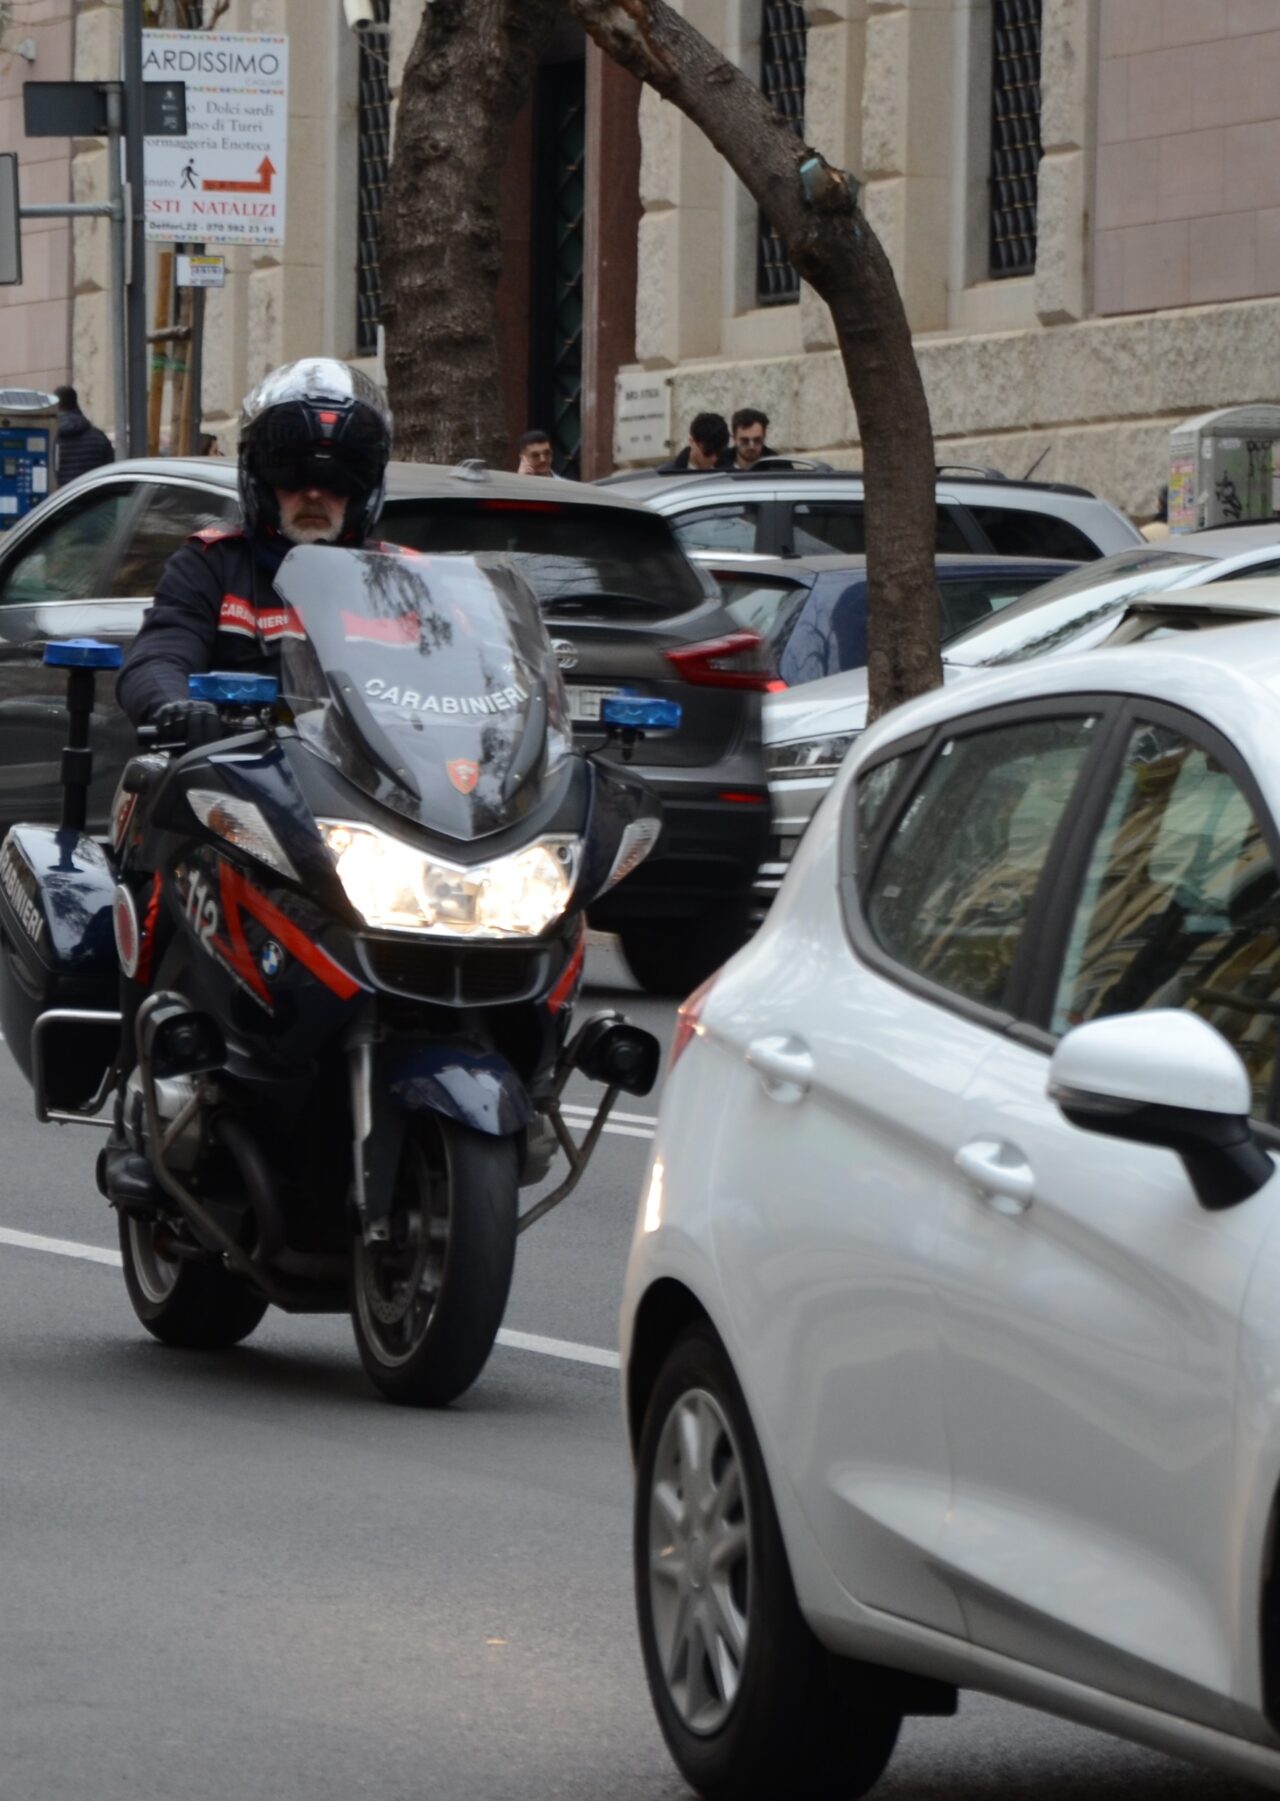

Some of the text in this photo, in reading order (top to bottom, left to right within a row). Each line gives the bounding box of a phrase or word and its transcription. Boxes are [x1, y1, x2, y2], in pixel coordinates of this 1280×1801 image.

[141, 49, 279, 75] ARDISSIMO
[206, 101, 240, 115] Dolci
[244, 103, 274, 116] sardi
[211, 119, 225, 131] di
[229, 120, 263, 132] Turri
[221, 138, 271, 151] Enoteca
[143, 199, 277, 217] ESTI NATALIZI
[364, 678, 529, 715] CARABINIERI
[186, 869, 219, 959] 112
